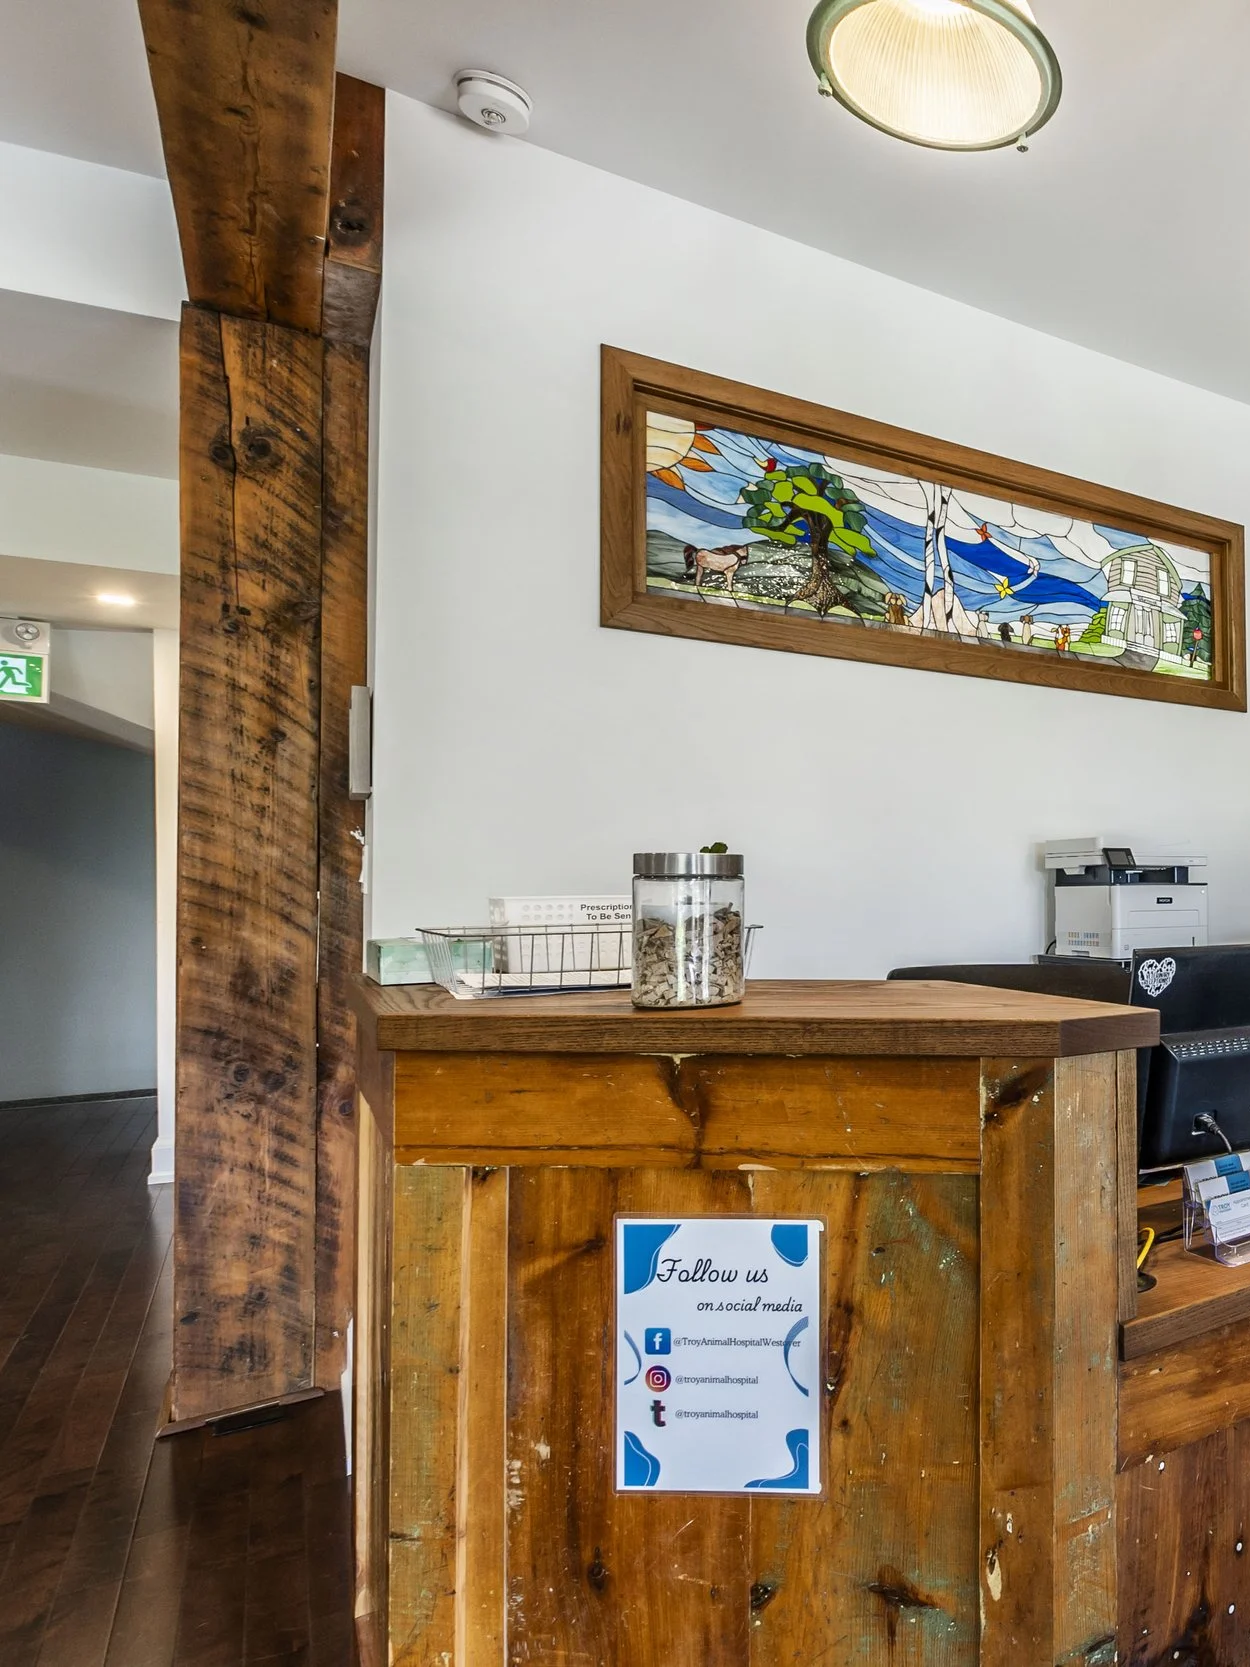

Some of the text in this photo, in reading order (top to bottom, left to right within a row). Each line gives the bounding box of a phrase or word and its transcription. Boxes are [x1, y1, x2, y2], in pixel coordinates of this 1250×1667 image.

[580, 903, 633, 912] Prescription
[586, 913, 597, 921] To
[599, 912, 612, 921] Be
[1217, 1201, 1231, 1210] TROY
[657, 1258, 769, 1284] Follow us
[697, 1297, 803, 1313] on social media
[675, 1375, 759, 1386] @troyanimalhospital
[675, 1410, 759, 1420] @troyanimalhospital
